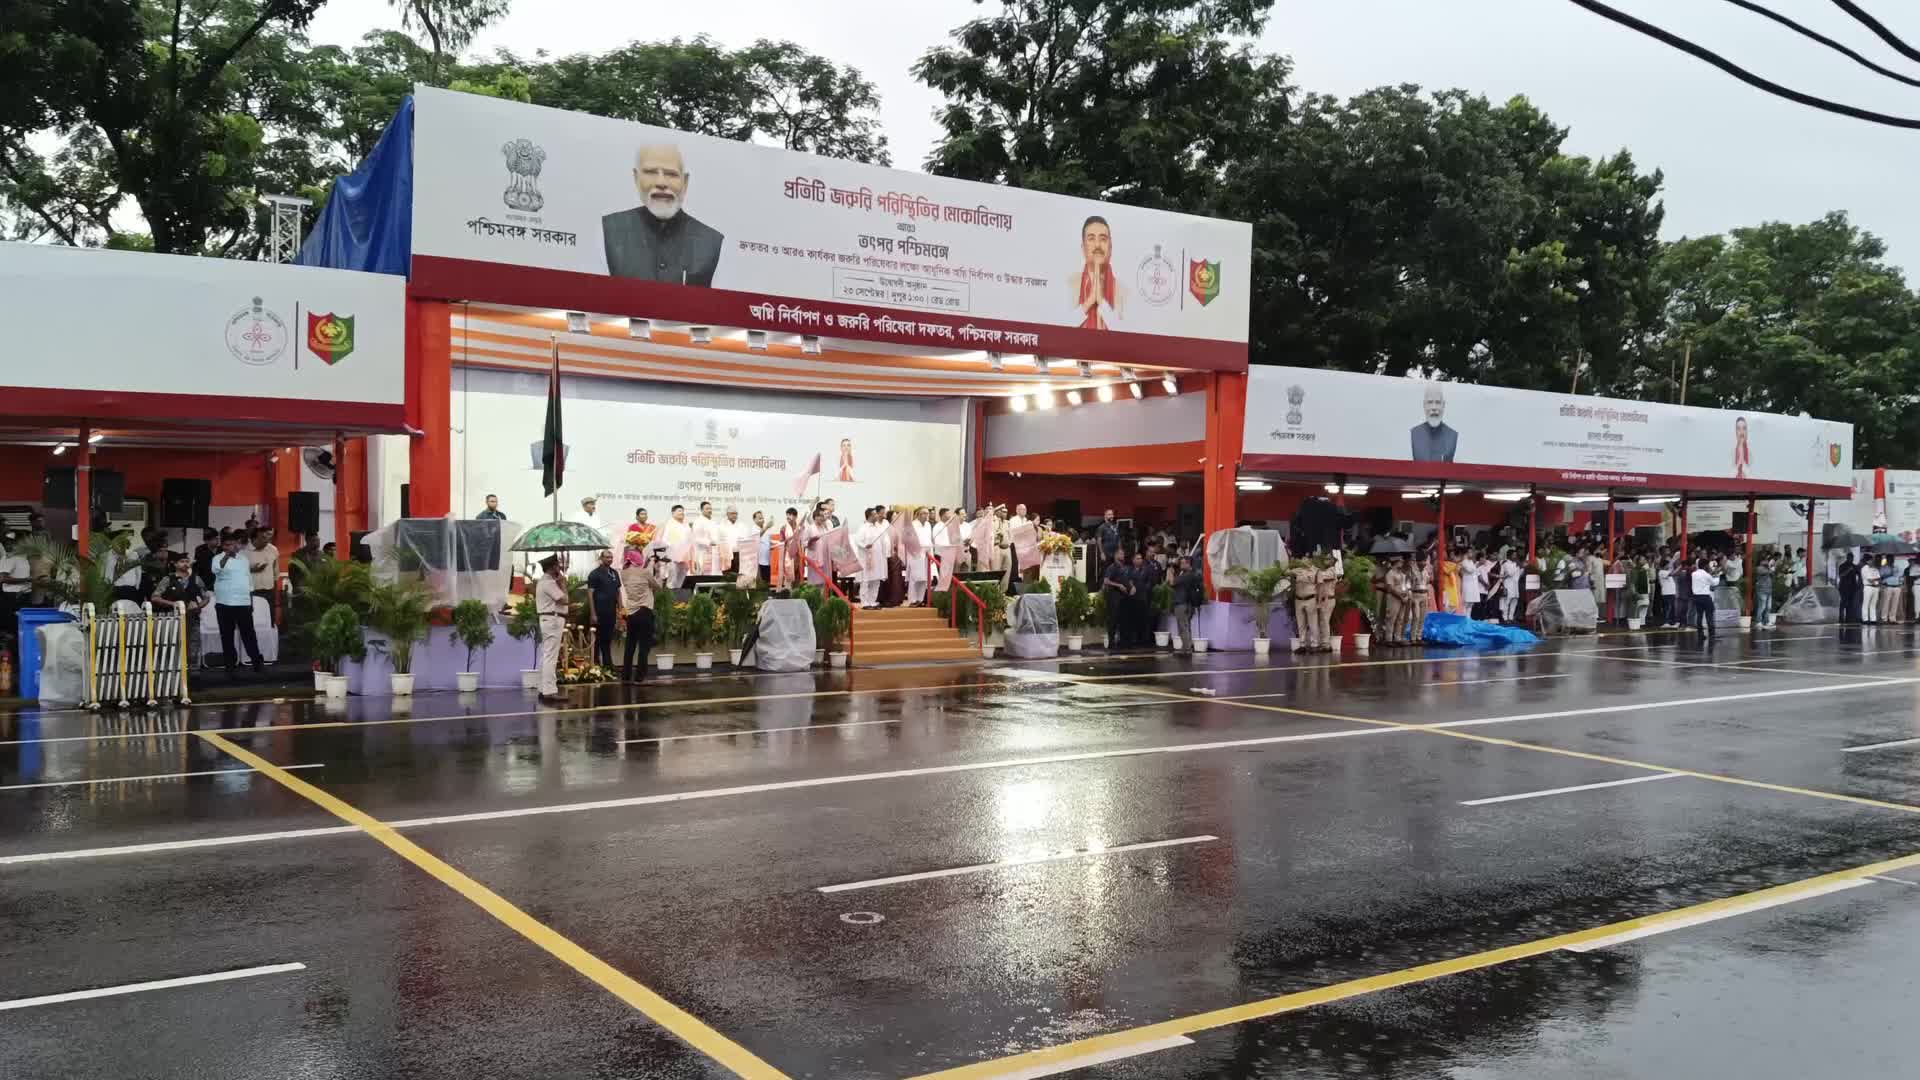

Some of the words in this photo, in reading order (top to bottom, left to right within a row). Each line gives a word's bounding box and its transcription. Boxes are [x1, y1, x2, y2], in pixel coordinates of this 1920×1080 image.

[784, 177, 825, 202] প্রতিটি
[830, 187, 872, 212] জরুরি
[877, 191, 939, 221] পরিস্থিতির
[943, 205, 1013, 232] মোকাবিলায়
[466, 217, 527, 240] পশ্চিমবঙ্গ
[530, 228, 576, 246] সরকার
[782, 246, 805, 257] আরও
[858, 234, 894, 255] তৎপর
[898, 236, 950, 261] পশ্চিমবঙ্গ
[749, 302, 775, 321] অগ্নি
[778, 304, 820, 326] নির্বাপণ
[824, 314, 833, 326] ও
[836, 312, 870, 331] জরুরি
[873, 315, 915, 336] পরিষেবা
[919, 322, 955, 341] দফতর,
[959, 324, 1001, 343] পশ্চিমবঙ্গ
[1004, 332, 1038, 346] সরকার
